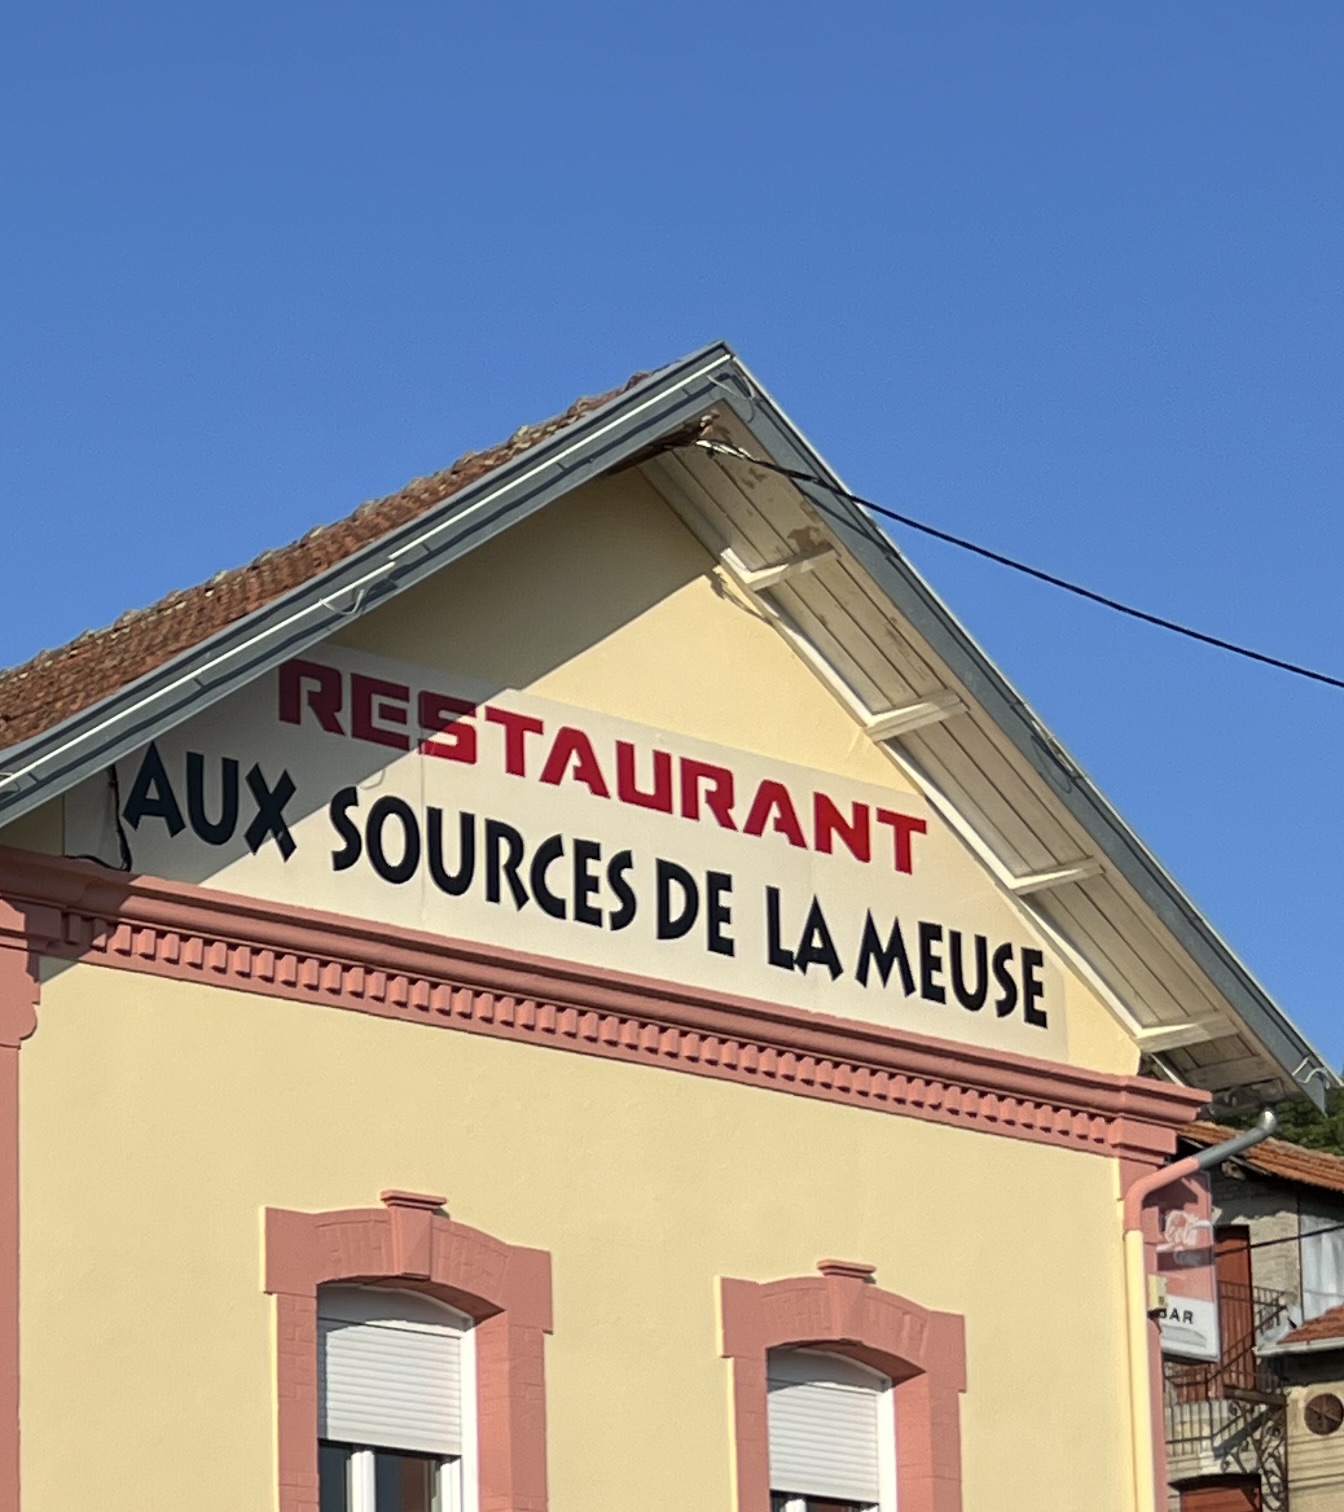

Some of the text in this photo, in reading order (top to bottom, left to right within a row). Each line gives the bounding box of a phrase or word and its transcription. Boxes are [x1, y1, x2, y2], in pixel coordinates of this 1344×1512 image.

[122, 741, 1048, 1029] AUX SOURCES DE LA MEUSE
[278, 657, 927, 875] RESTAURANT
